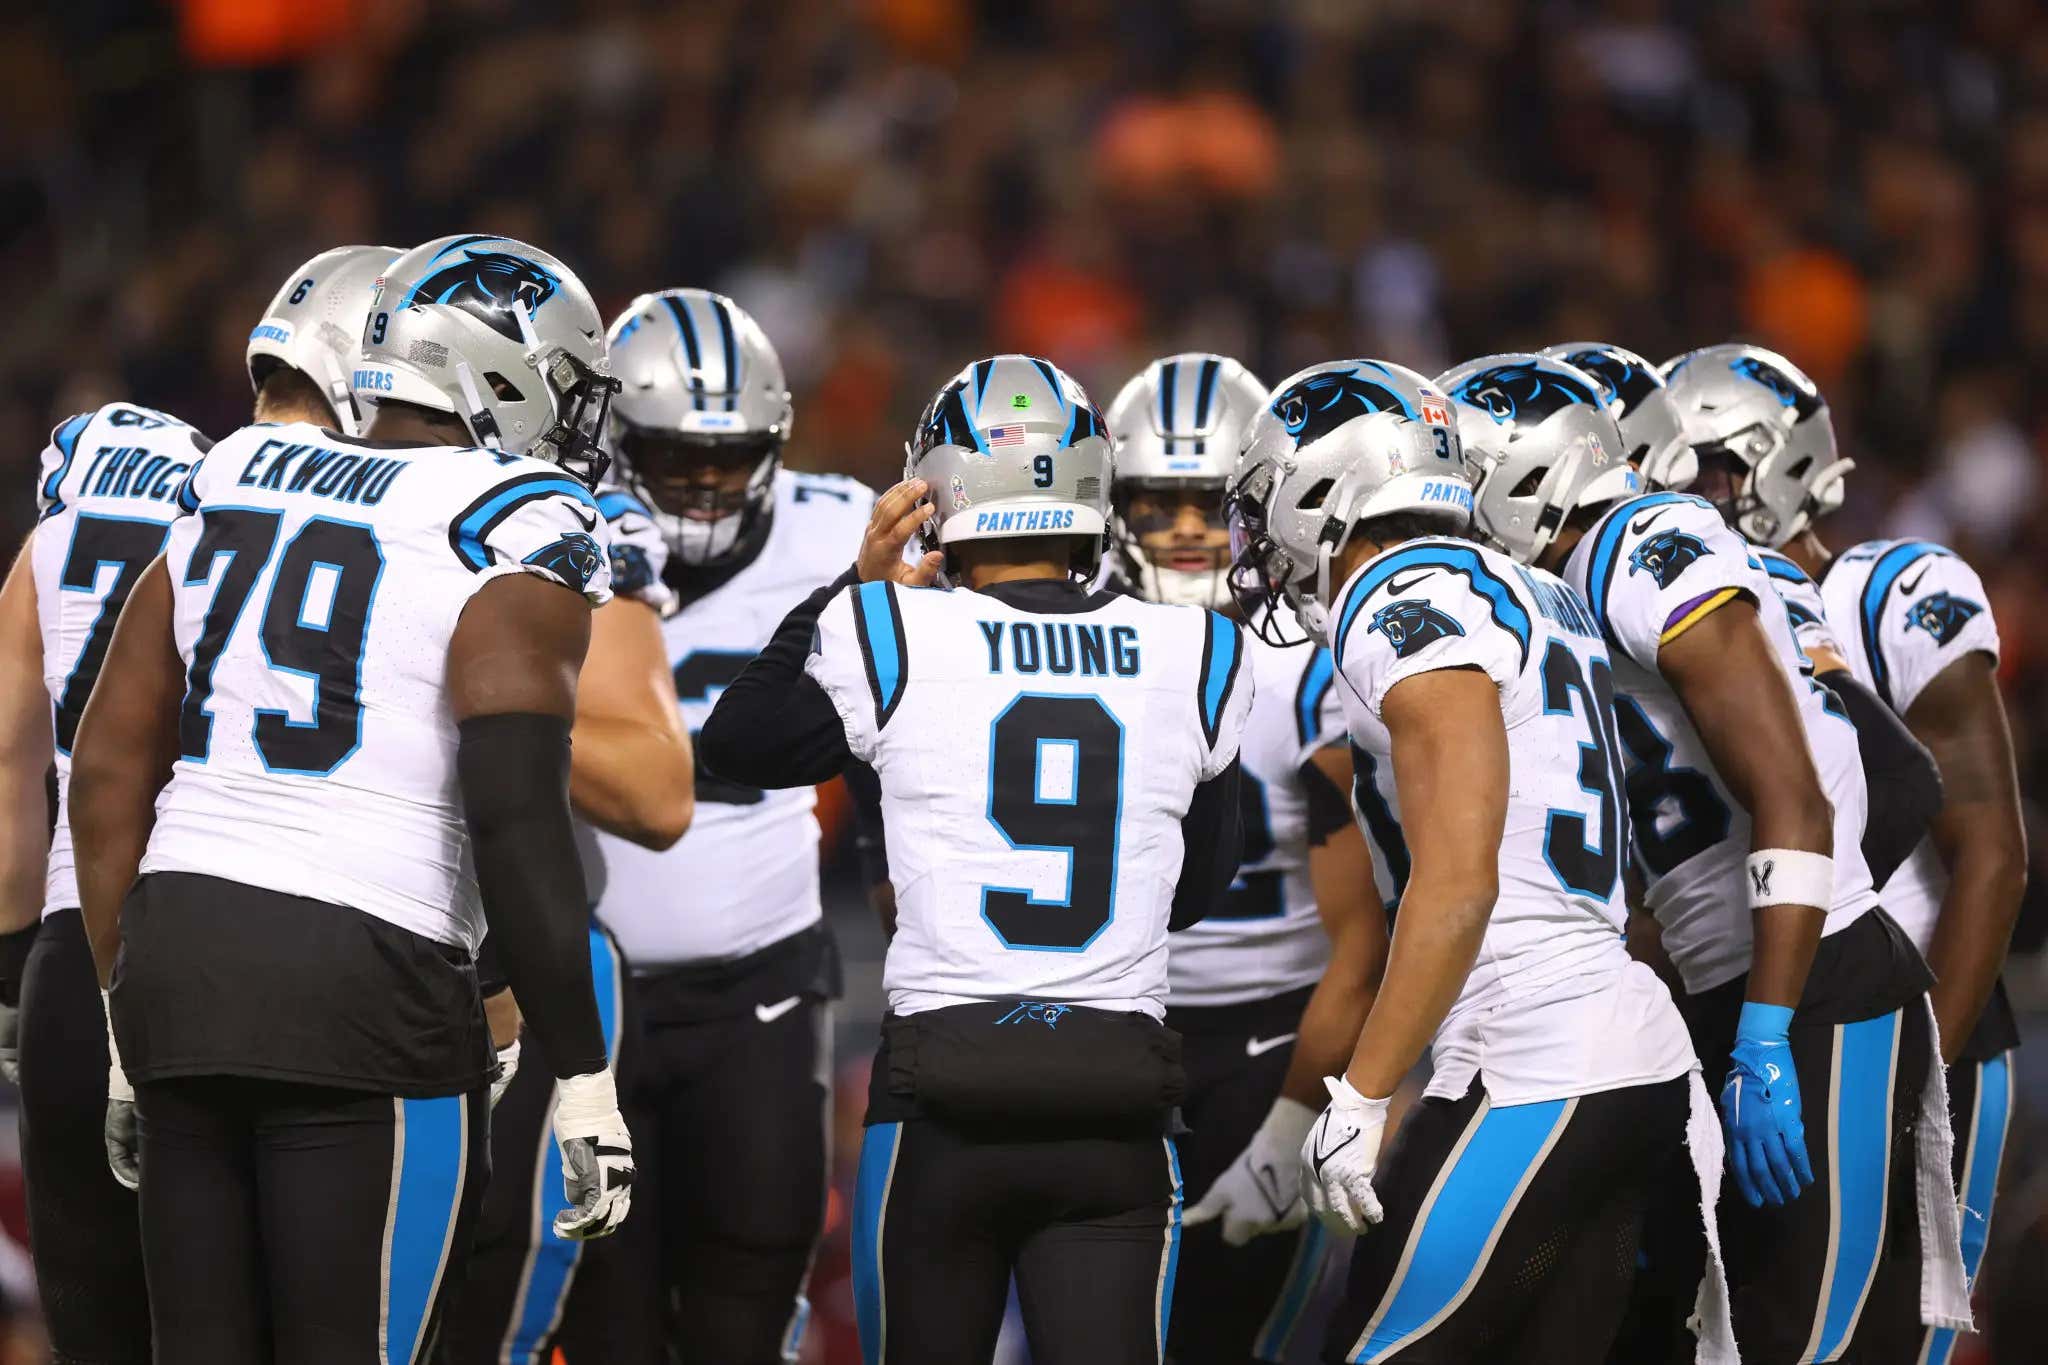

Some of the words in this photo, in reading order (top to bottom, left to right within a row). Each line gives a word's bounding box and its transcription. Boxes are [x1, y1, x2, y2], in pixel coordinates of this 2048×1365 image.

[78, 446, 190, 505] THROC
[236, 438, 413, 506] EKWONU
[1033, 454, 1054, 488] 9
[976, 509, 1074, 532] PANTHERS
[180, 504, 387, 778] 79
[976, 620, 1141, 677] YOUNG
[979, 690, 1126, 953] 9
